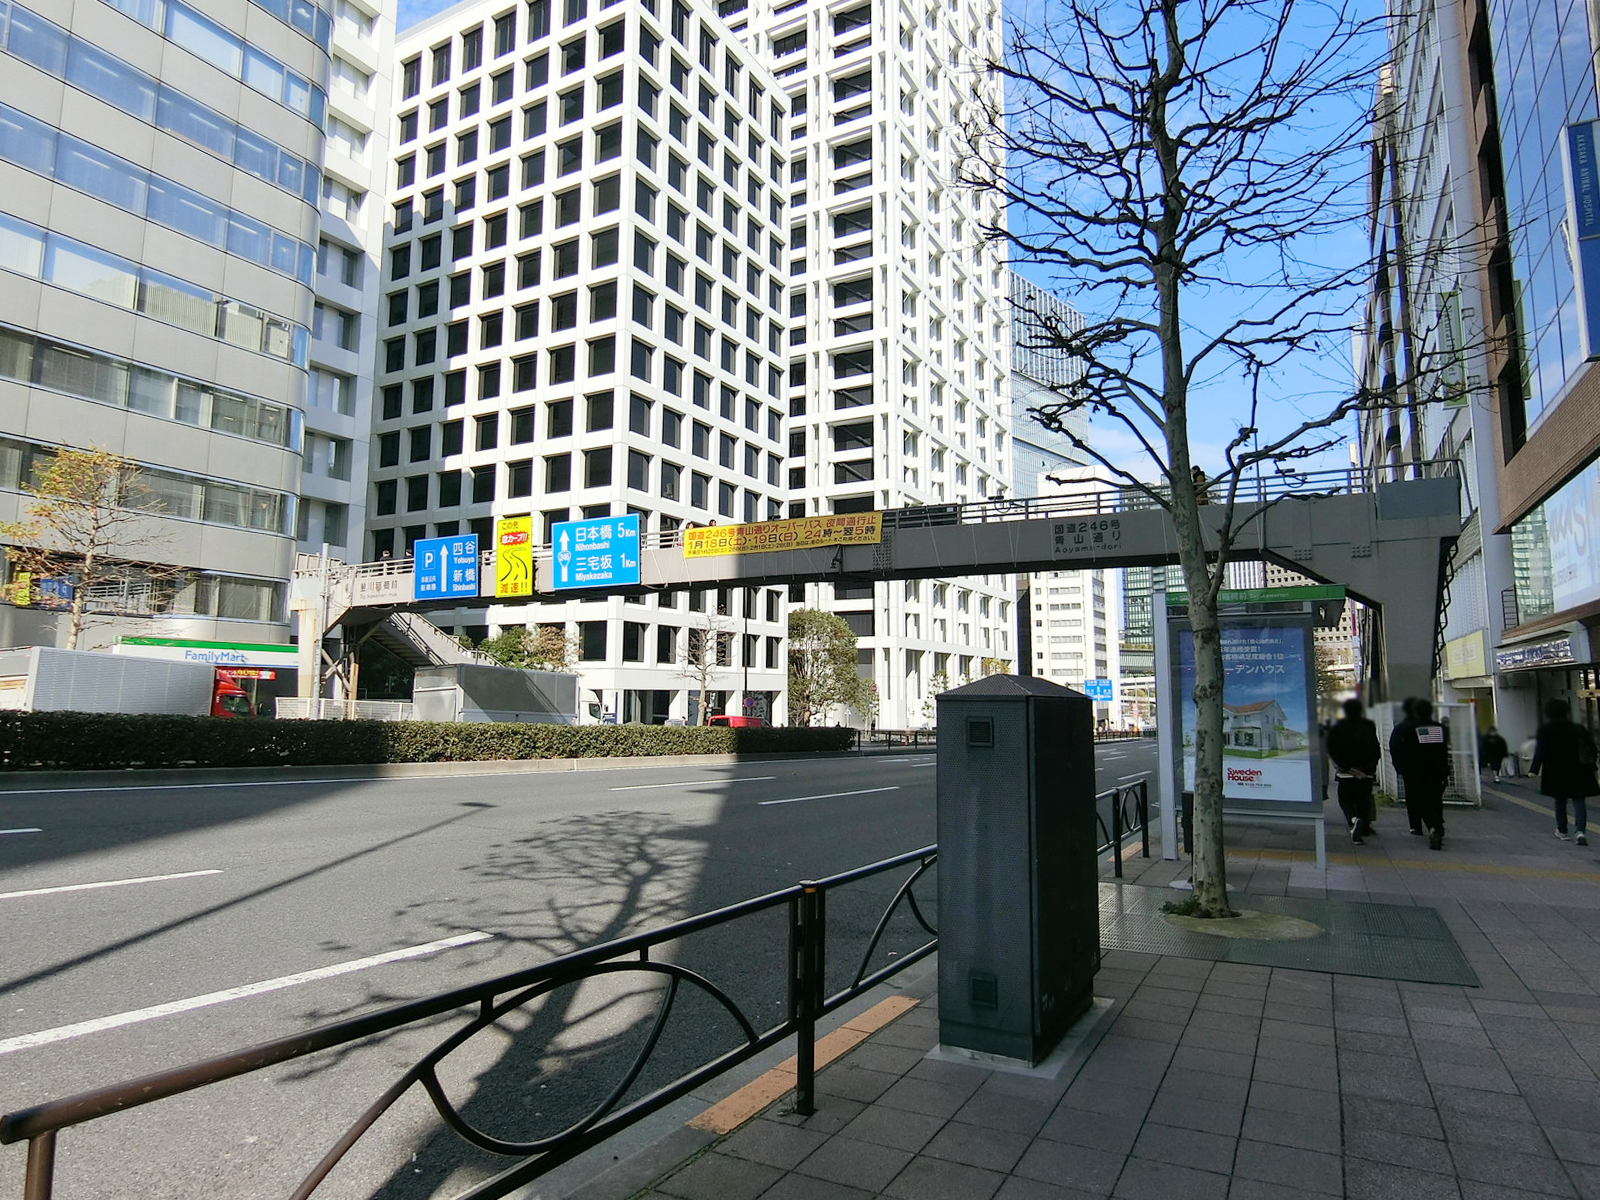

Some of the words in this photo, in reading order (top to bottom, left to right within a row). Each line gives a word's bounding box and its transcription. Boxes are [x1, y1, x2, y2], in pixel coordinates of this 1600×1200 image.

[1577, 134, 1588, 163] AKASAKA
[1581, 168, 1591, 193] ANIMAL
[1583, 195, 1594, 227] HOSPITAL
[502, 521, 518, 530] この先
[826, 515, 876, 528] 夜間通行止
[1054, 520, 1120, 534] 国道246号
[575, 525, 612, 542] 日本橋
[453, 541, 475, 556] 四谷
[575, 541, 610, 551] Nihonbashi
[425, 552, 433, 568] P
[453, 556, 475, 564] Yotsuya
[575, 554, 613, 571] 三宅坂
[453, 568, 475, 582] 新橋
[575, 571, 613, 582] Miyakezaka
[452, 583, 476, 591] Shinbashi
[185, 650, 245, 664] FamilyMart
[1227, 768, 1262, 776] Sweden
[1227, 773, 1254, 782] House
